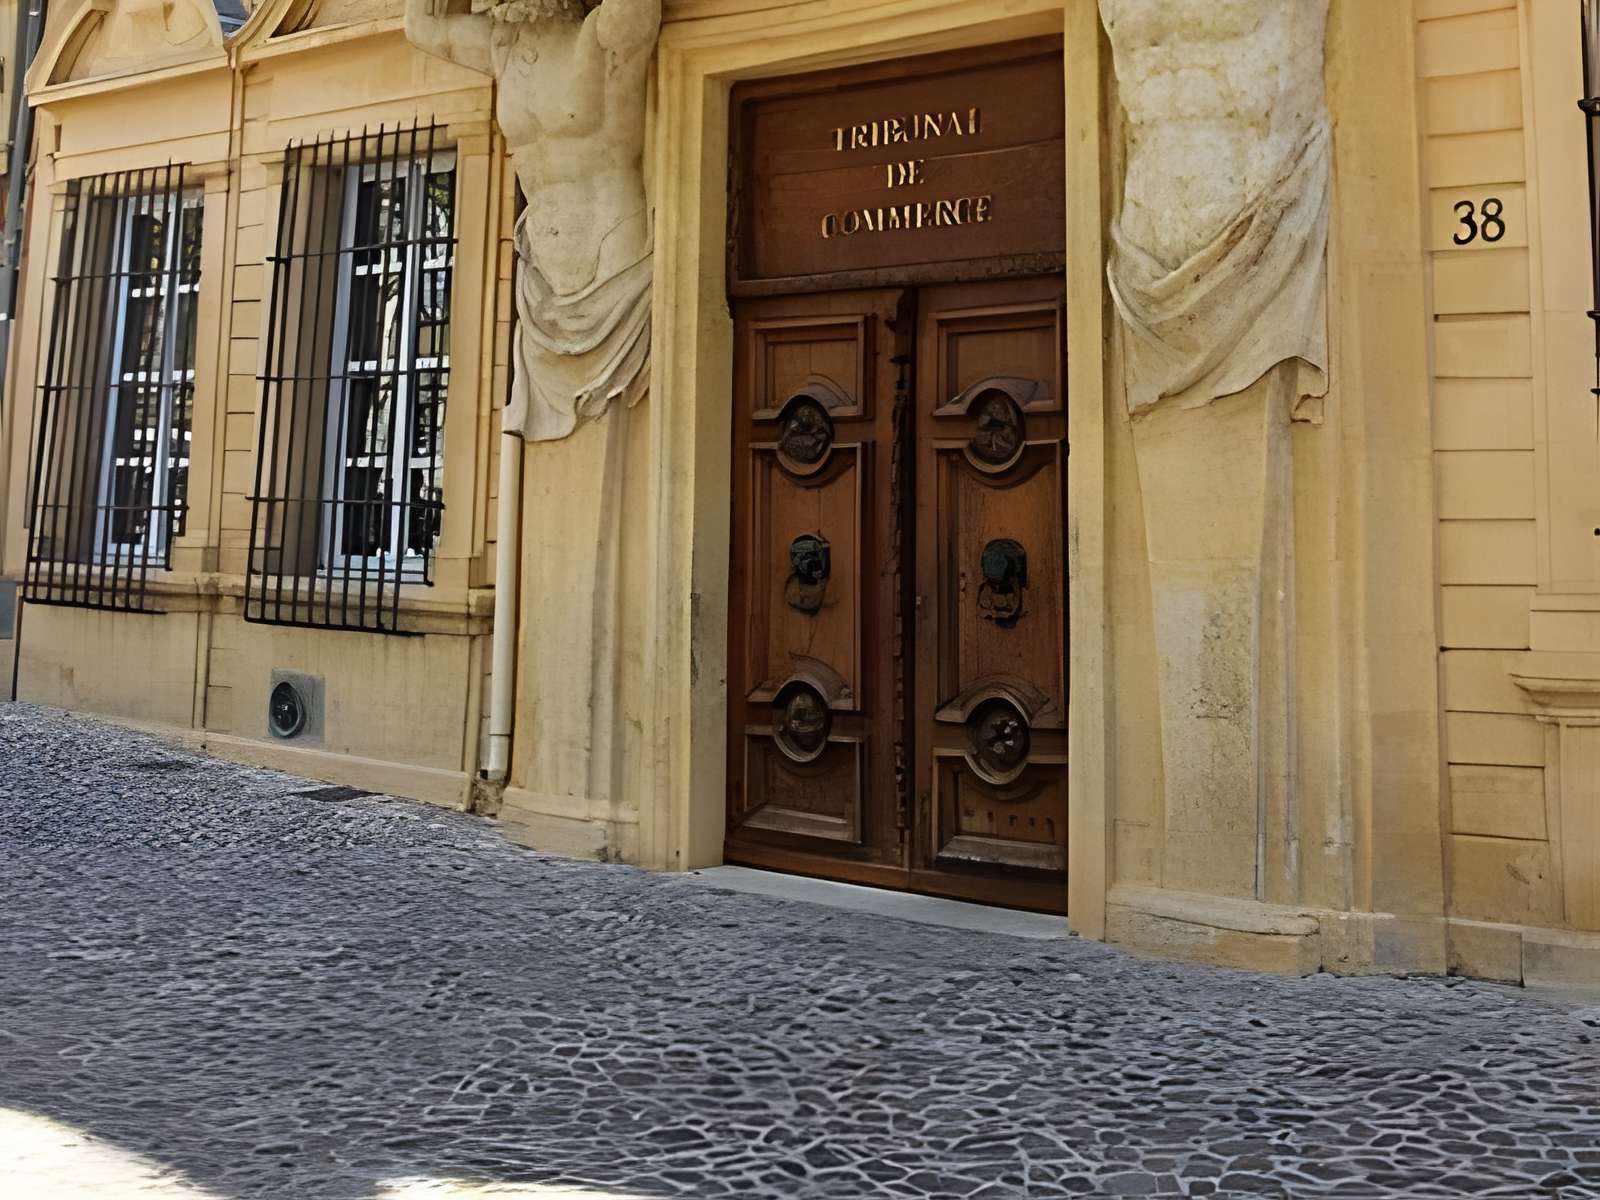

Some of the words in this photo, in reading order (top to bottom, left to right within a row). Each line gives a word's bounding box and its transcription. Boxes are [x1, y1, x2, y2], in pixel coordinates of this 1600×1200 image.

[887, 159, 925, 188] DE
[821, 196, 992, 239] COMMERCE
[1453, 198, 1505, 245] 38
